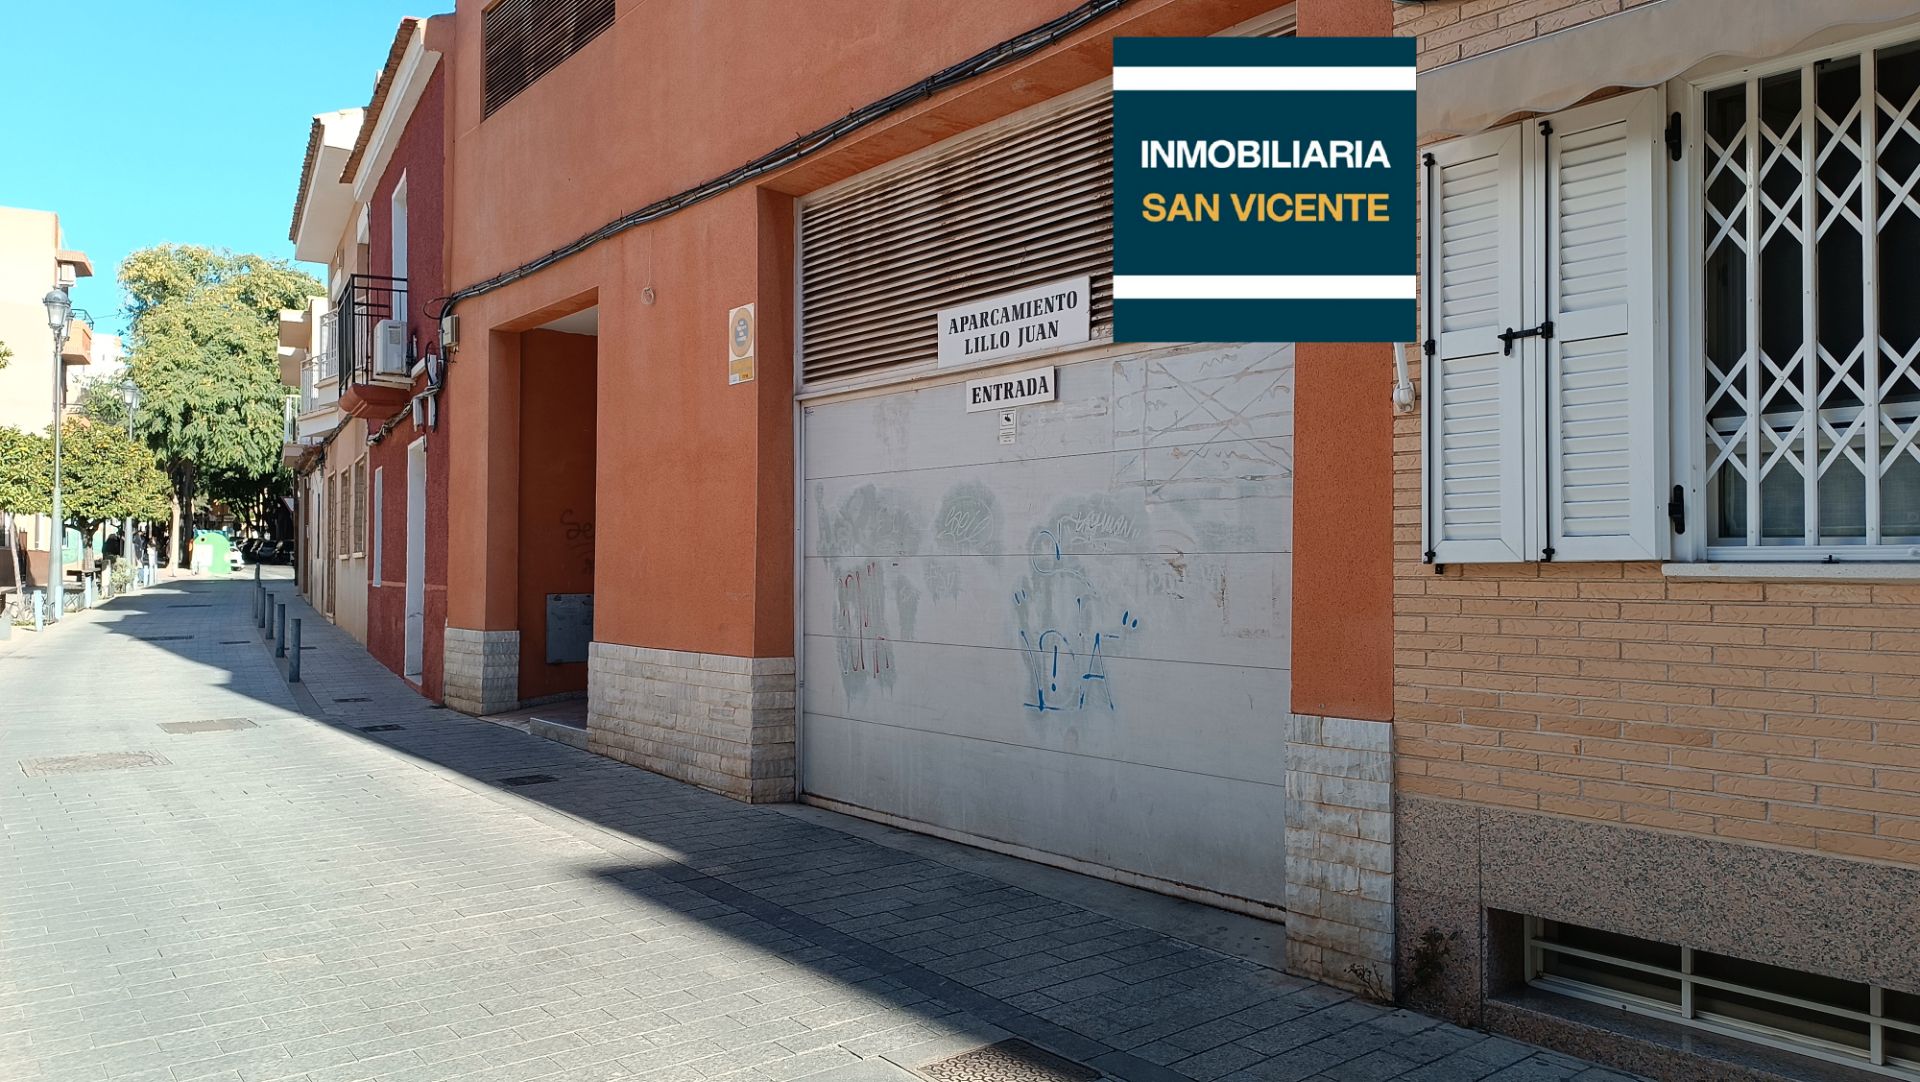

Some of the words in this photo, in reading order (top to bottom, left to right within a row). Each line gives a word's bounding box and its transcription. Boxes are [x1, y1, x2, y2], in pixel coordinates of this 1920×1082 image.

[948, 290, 1078, 335] APARCAMIENTO
[964, 330, 1010, 355] LILLO
[1018, 320, 1059, 348] JUAN
[972, 376, 1049, 404] ENTRADA
